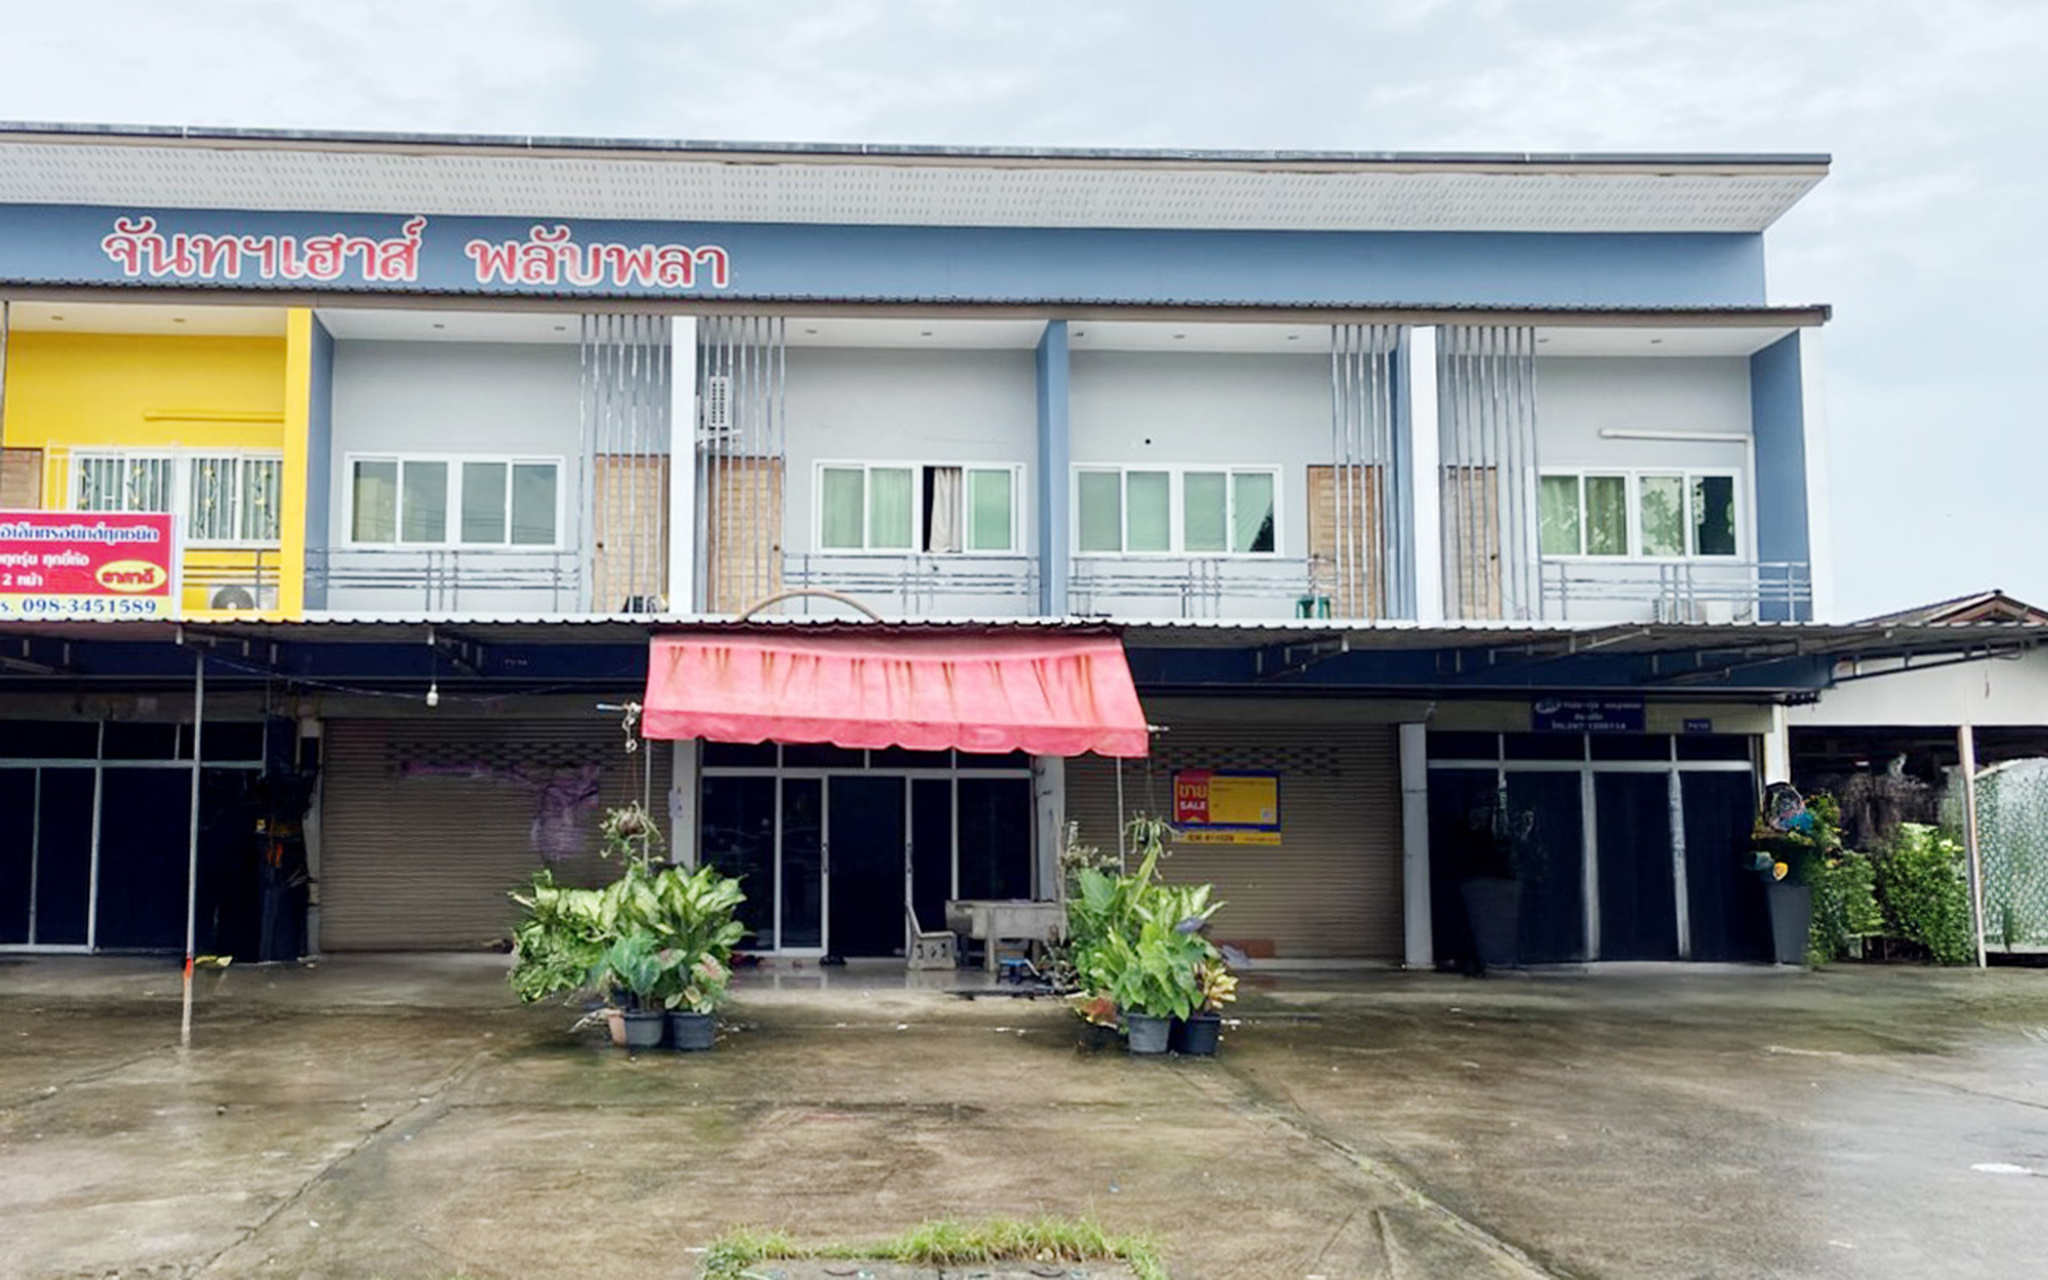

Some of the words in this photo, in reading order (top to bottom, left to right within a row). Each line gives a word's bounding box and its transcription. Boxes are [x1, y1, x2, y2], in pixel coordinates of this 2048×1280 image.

[102, 216, 427, 281] จันทฯเฮาส์
[465, 225, 729, 287] พลับพลา
[2, 574, 12, 586] 2
[22, 599, 156, 614] 098-3451589
[1180, 784, 1207, 799] ขาย
[1180, 801, 1206, 811] SALE
